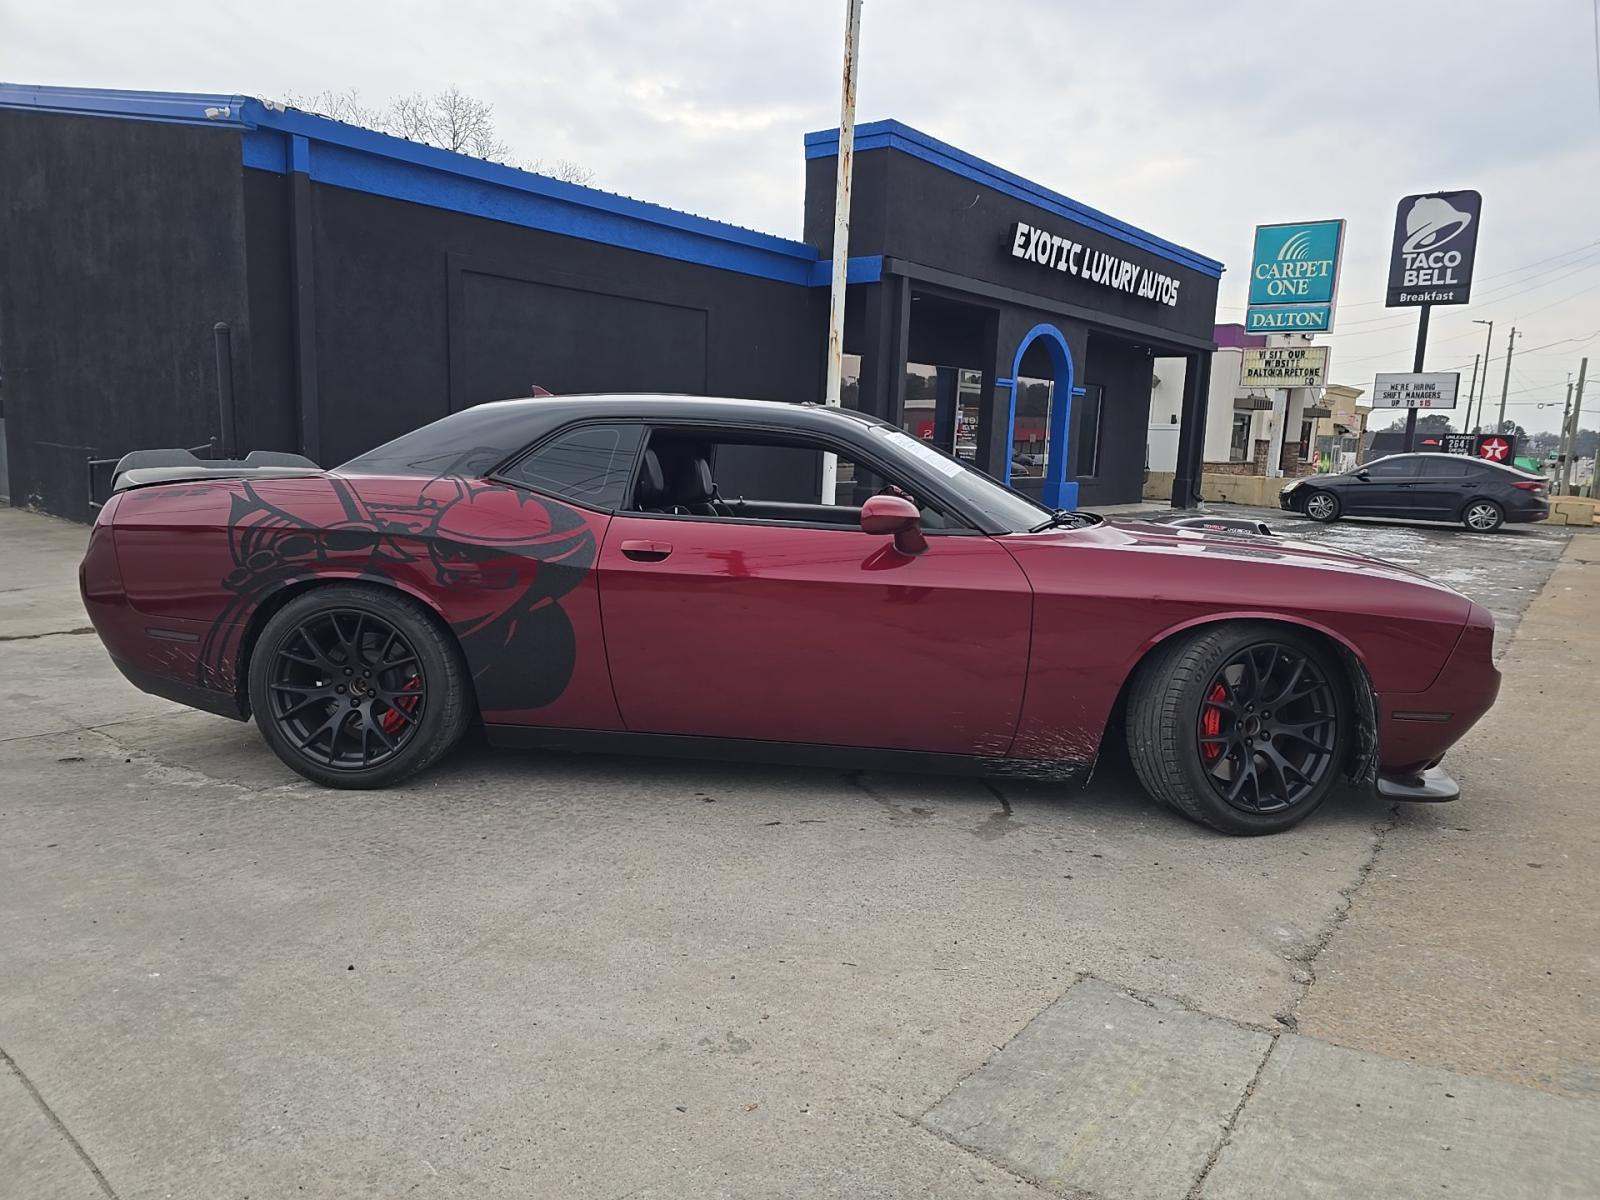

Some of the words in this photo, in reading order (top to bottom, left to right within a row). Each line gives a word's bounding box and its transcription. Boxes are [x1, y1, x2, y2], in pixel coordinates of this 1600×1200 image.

[1012, 222, 1082, 275] EXOTIC
[1081, 247, 1140, 293] LUXURY
[1137, 269, 1180, 307] AUTOS
[1402, 250, 1462, 270] TACO
[1255, 260, 1332, 279] CARPET
[1403, 267, 1458, 286] BELL
[1267, 279, 1309, 295] ONE
[1400, 291, 1454, 302] Breakfast
[1252, 312, 1324, 327] DALTON
[1288, 350, 1306, 359] OUR
[1413, 383, 1436, 391] HIRING
[1405, 391, 1441, 399] MANAGERS
[1419, 399, 1431, 407] $15
